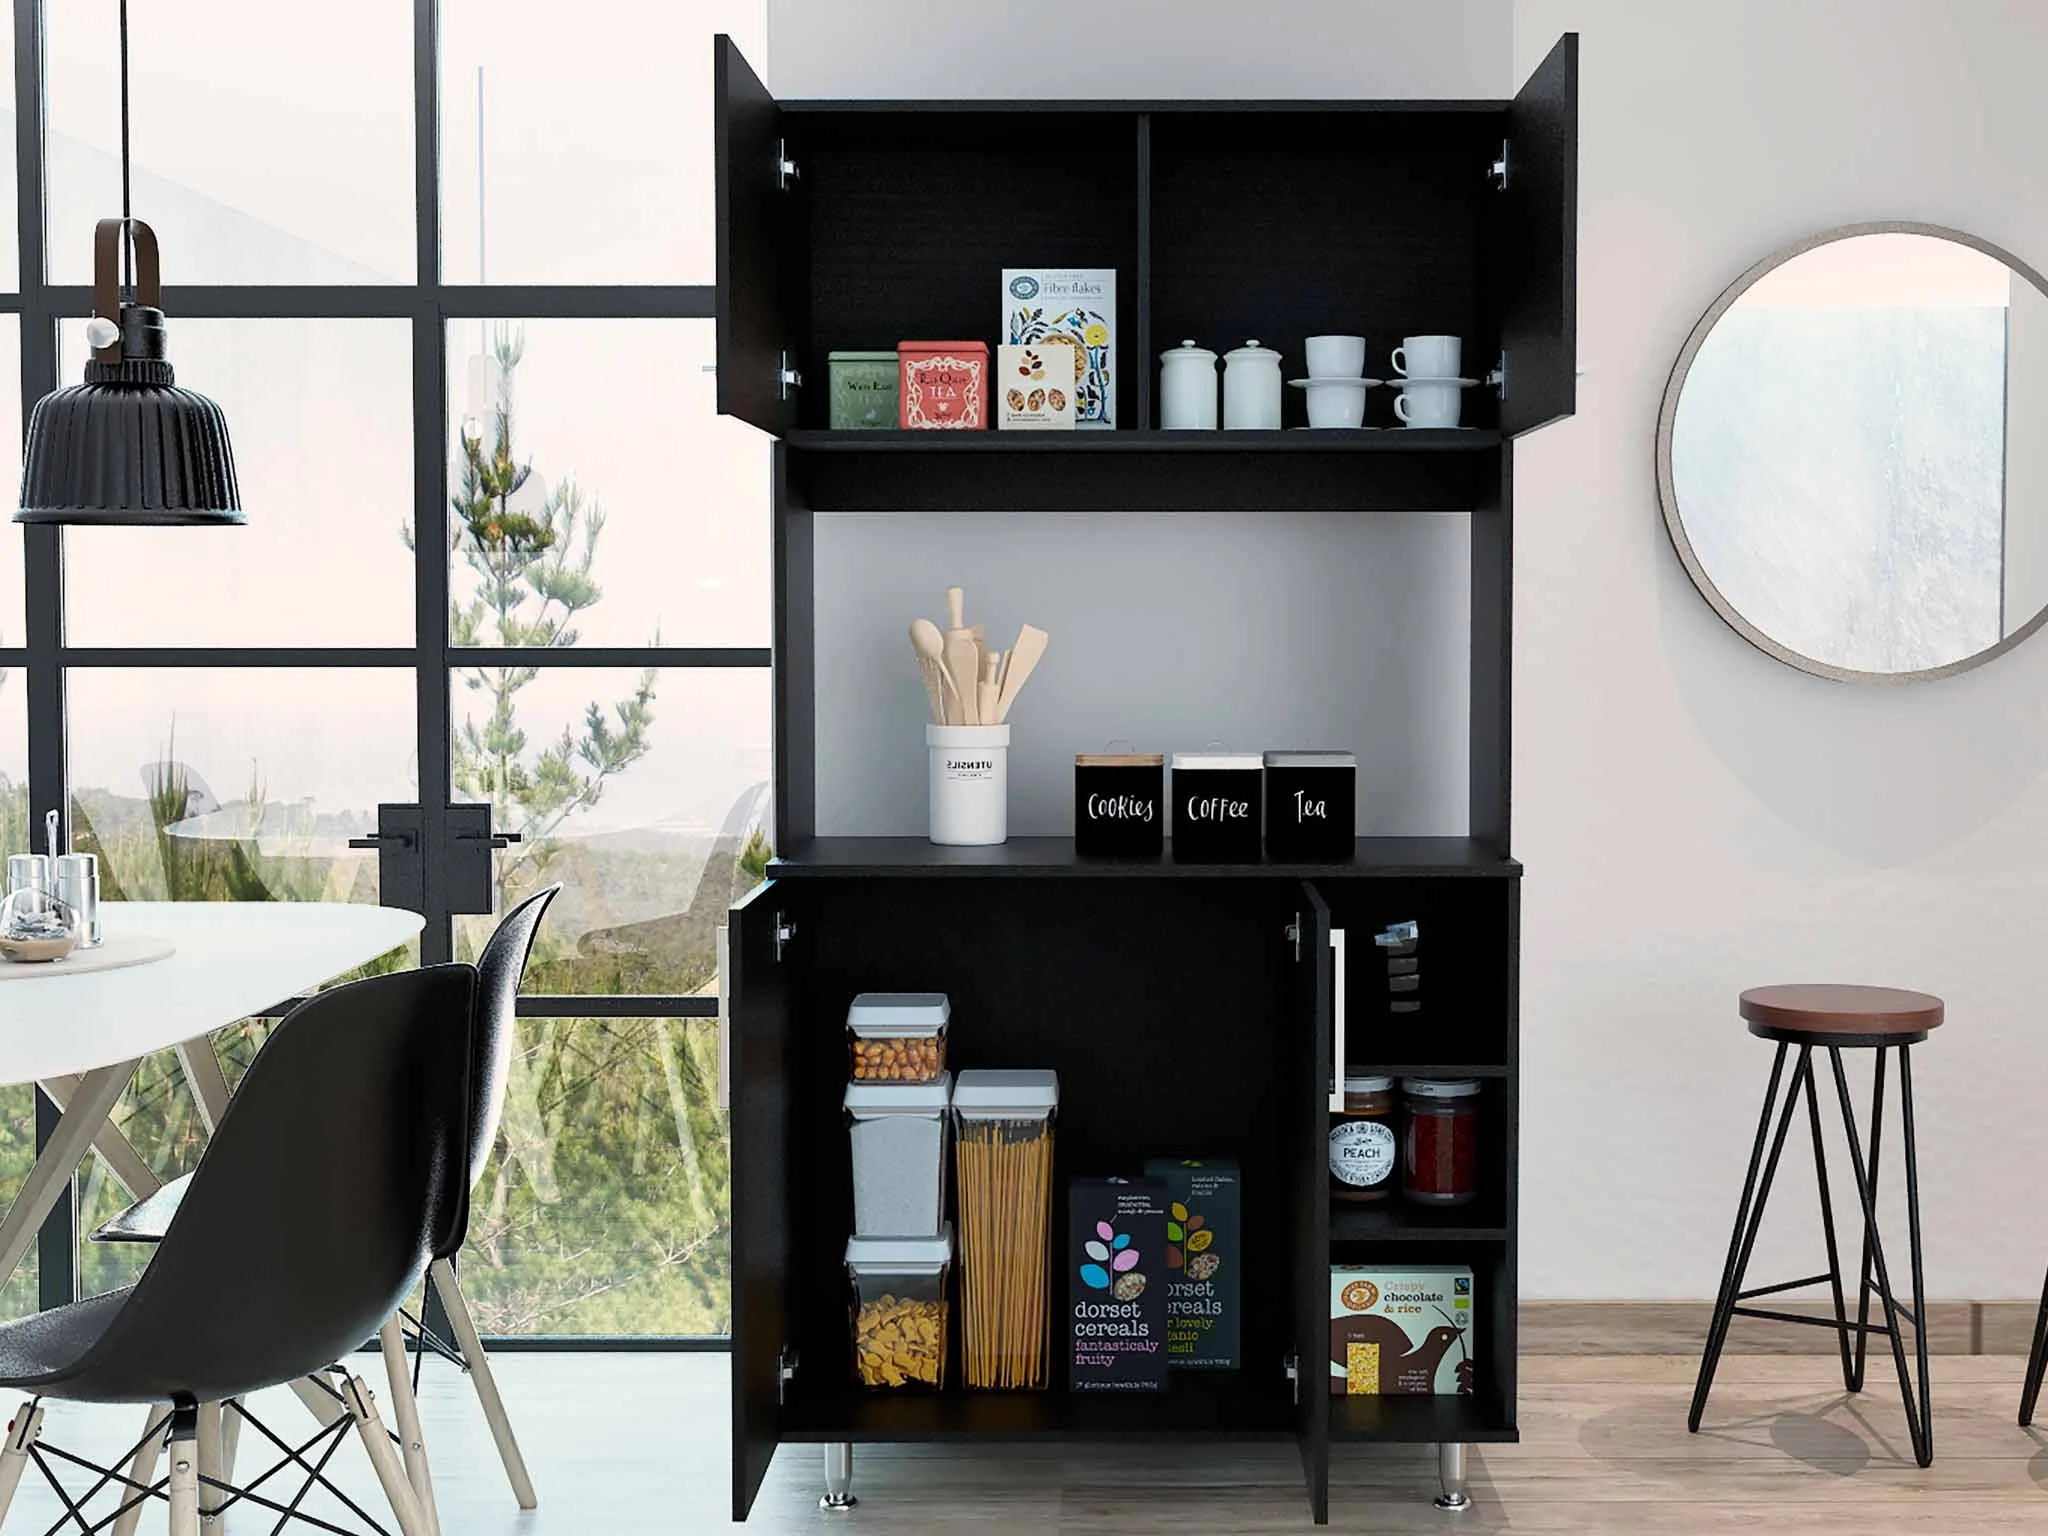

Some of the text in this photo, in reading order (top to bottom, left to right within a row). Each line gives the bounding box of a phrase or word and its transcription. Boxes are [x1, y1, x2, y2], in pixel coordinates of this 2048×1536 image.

[1088, 793, 1154, 823] Cookies
[1293, 789, 1328, 824] Tea
[1343, 1147, 1381, 1159] PEACH
[1167, 1280, 1216, 1297] orset
[1384, 1292, 1444, 1302] chocolate
[1074, 1300, 1142, 1319] dorset
[1397, 1303, 1422, 1313] rice
[1074, 1319, 1150, 1337] cereals
[1075, 1353, 1116, 1368] fruity
